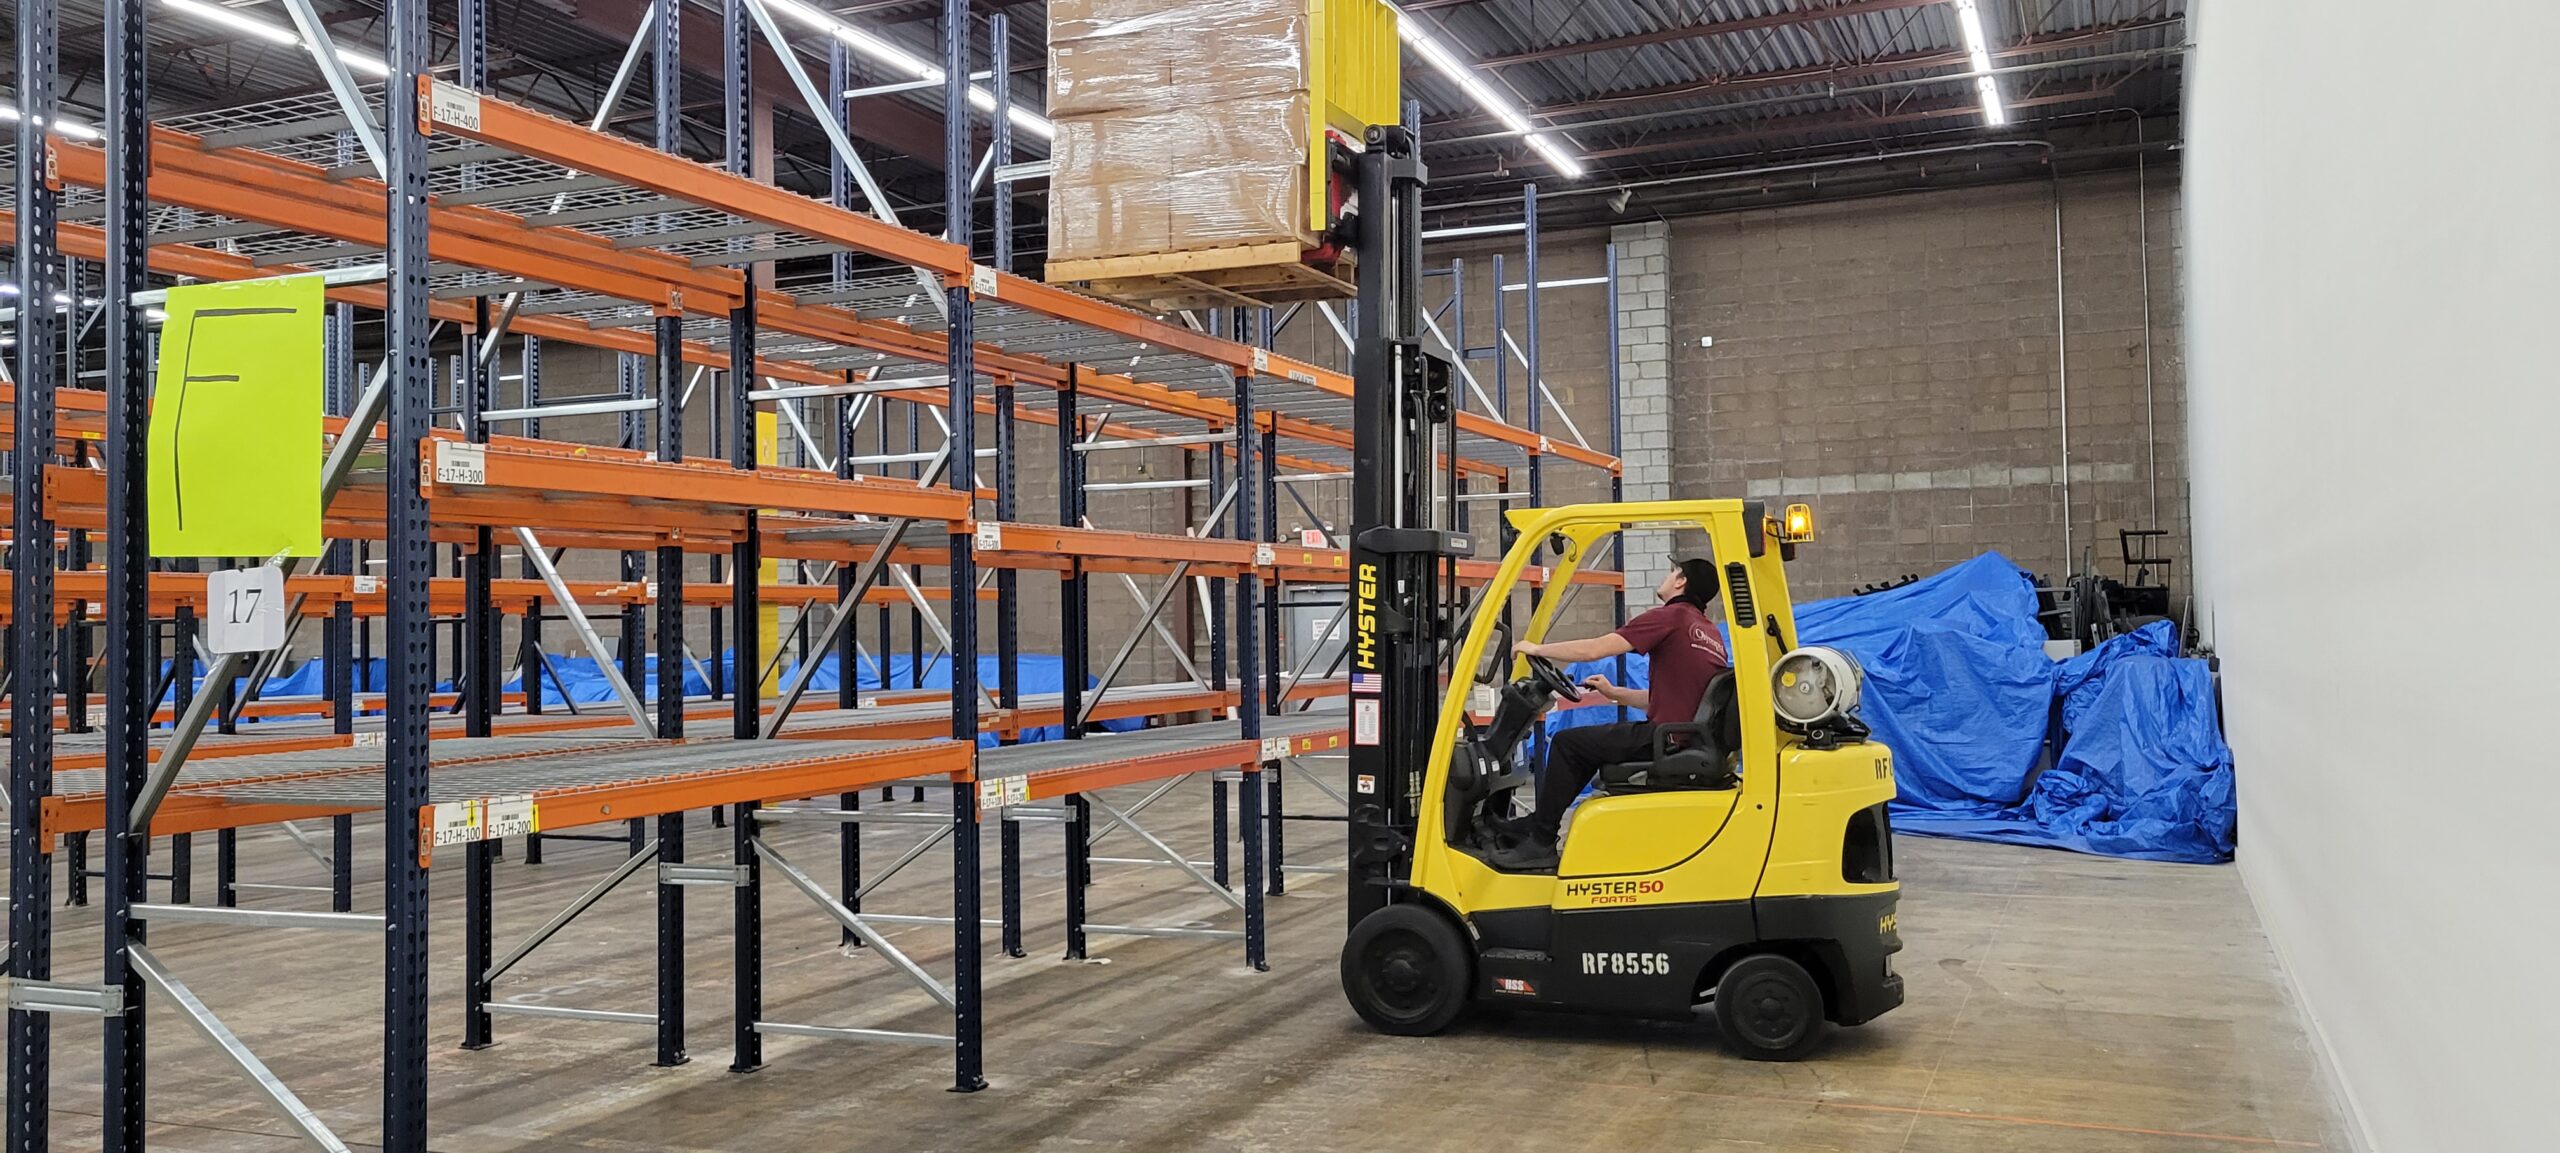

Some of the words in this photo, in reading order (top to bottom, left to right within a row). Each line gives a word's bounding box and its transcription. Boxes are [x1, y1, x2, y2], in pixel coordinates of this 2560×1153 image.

[433, 105, 479, 130] F-17-H-400
[174, 308, 297, 531] F
[437, 467, 484, 484] F-17-H-300
[228, 588, 263, 624] 17
[1357, 563, 1377, 670] HYSTER
[435, 826, 481, 845] F-17-H-100
[488, 820, 532, 838] F-17-H-200
[1566, 881, 1637, 897] HYSTER
[1639, 880, 1664, 894] 50
[1591, 894, 1638, 905] FORTIS
[1581, 952, 1670, 975] RF8556
